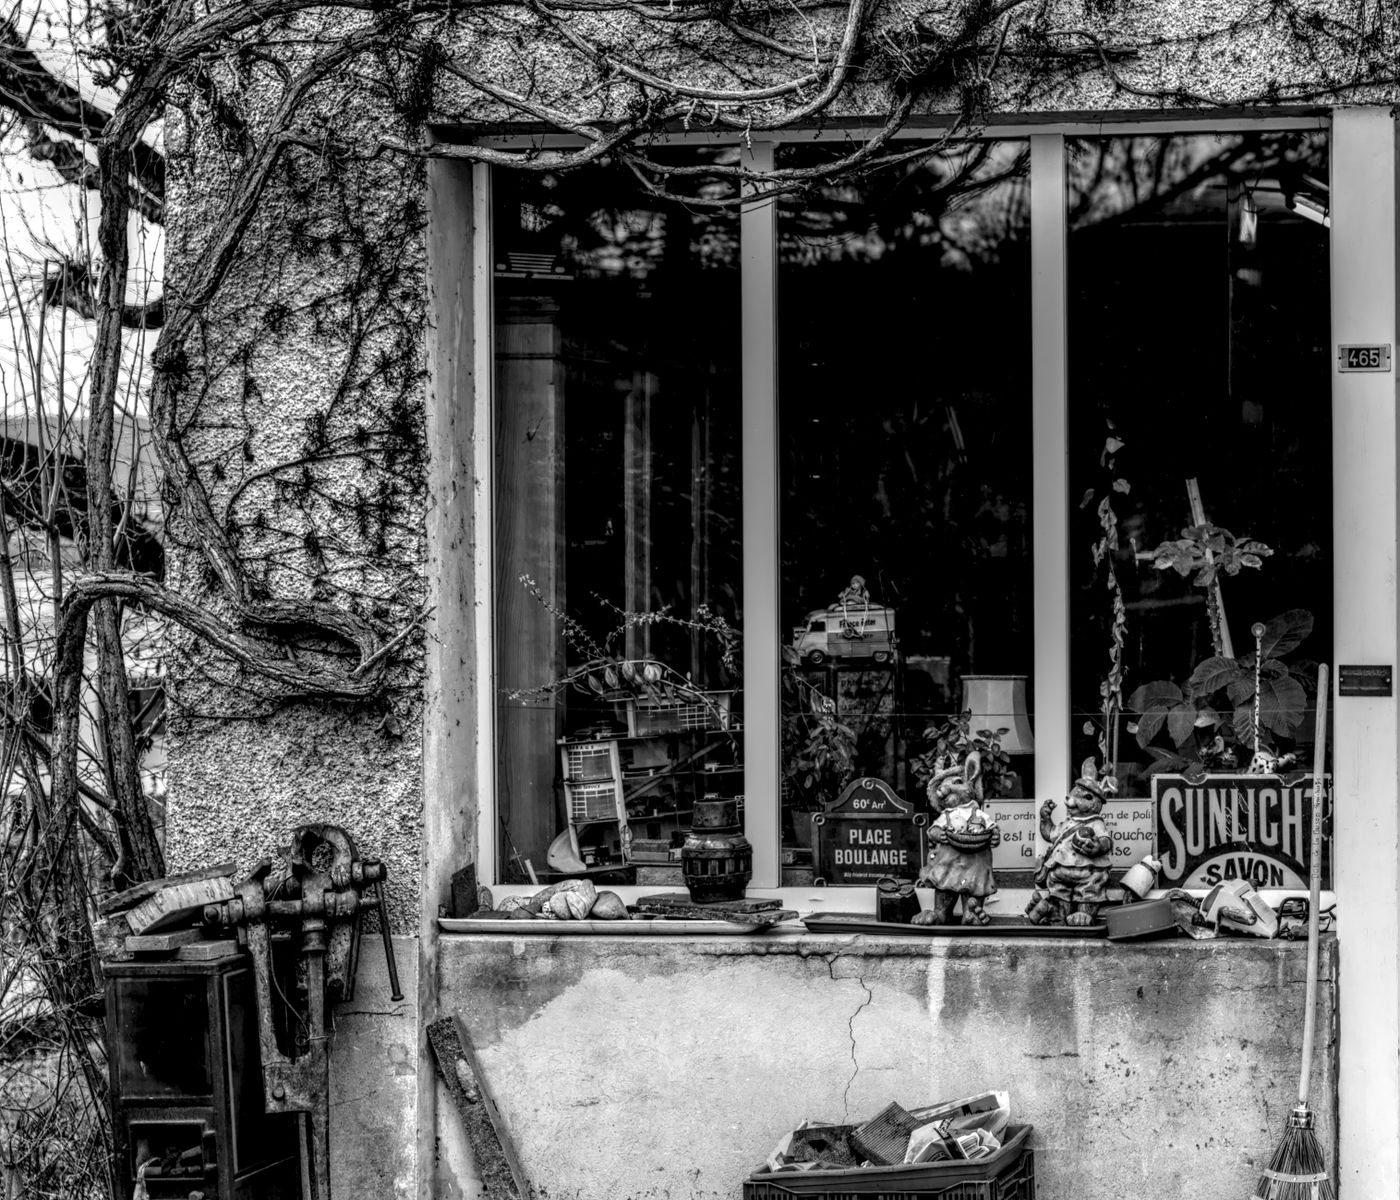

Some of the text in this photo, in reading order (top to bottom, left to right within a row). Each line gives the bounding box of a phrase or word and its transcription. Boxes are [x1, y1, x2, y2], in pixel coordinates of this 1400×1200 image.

[1349, 350, 1379, 367] 465
[994, 812, 1011, 823] Par
[1116, 810, 1129, 819] de
[1132, 809, 1151, 821] poli
[849, 829, 892, 845] PLACE
[1003, 831, 1022, 842] est
[834, 849, 908, 865] BOULANGE
[1021, 844, 1033, 857] la
[1206, 857, 1284, 887] SAVON
